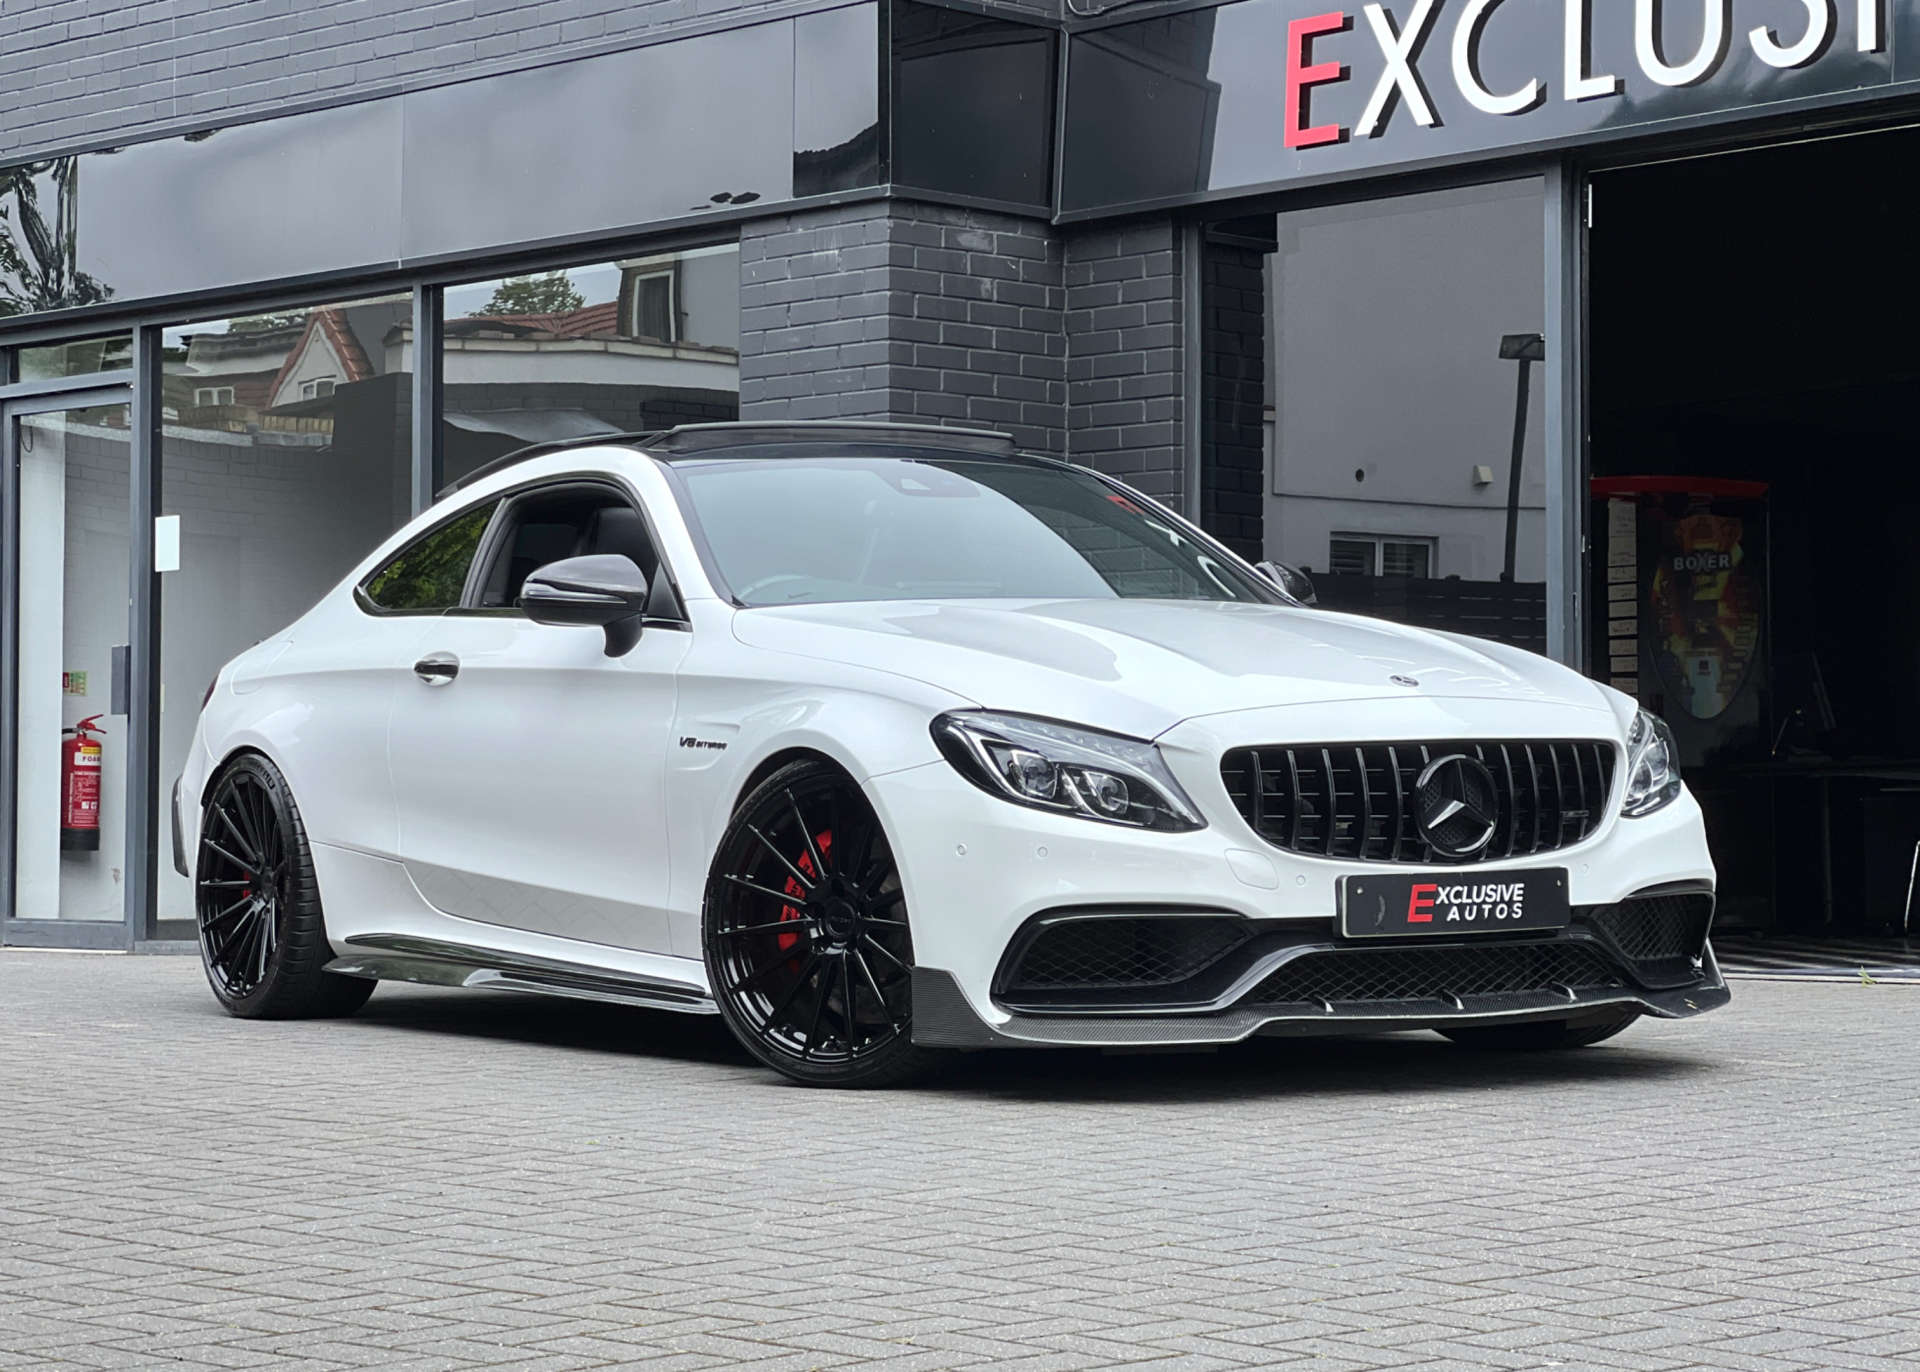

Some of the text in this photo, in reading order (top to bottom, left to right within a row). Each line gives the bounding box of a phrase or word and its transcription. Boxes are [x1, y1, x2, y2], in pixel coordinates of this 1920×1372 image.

[1673, 552, 1730, 573] BOXER
[1407, 883, 1525, 922] EXCLUSIVE
[1447, 902, 1523, 921] AUTOS
